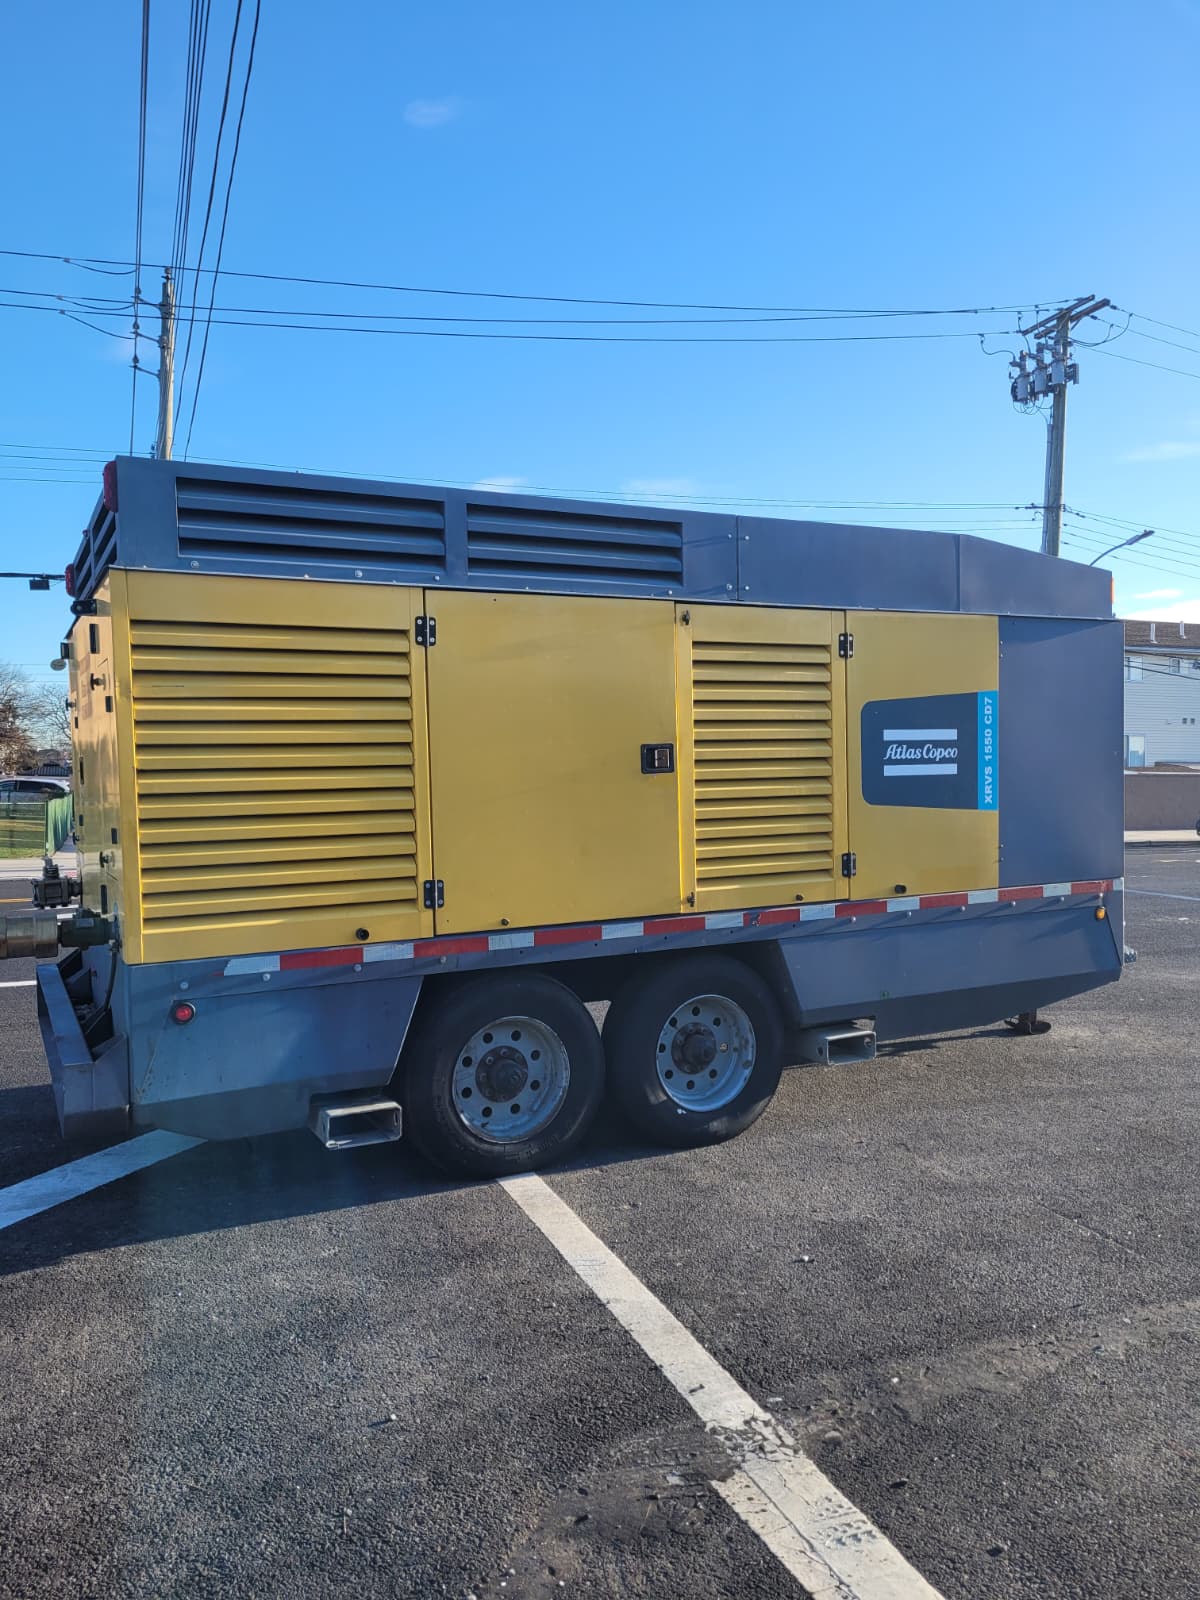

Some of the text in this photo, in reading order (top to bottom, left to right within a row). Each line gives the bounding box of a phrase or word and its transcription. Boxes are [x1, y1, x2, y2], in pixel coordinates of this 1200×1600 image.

[883, 744, 958, 762] Atlas Copco
[984, 696, 993, 804] XRVS 1550 CD7
